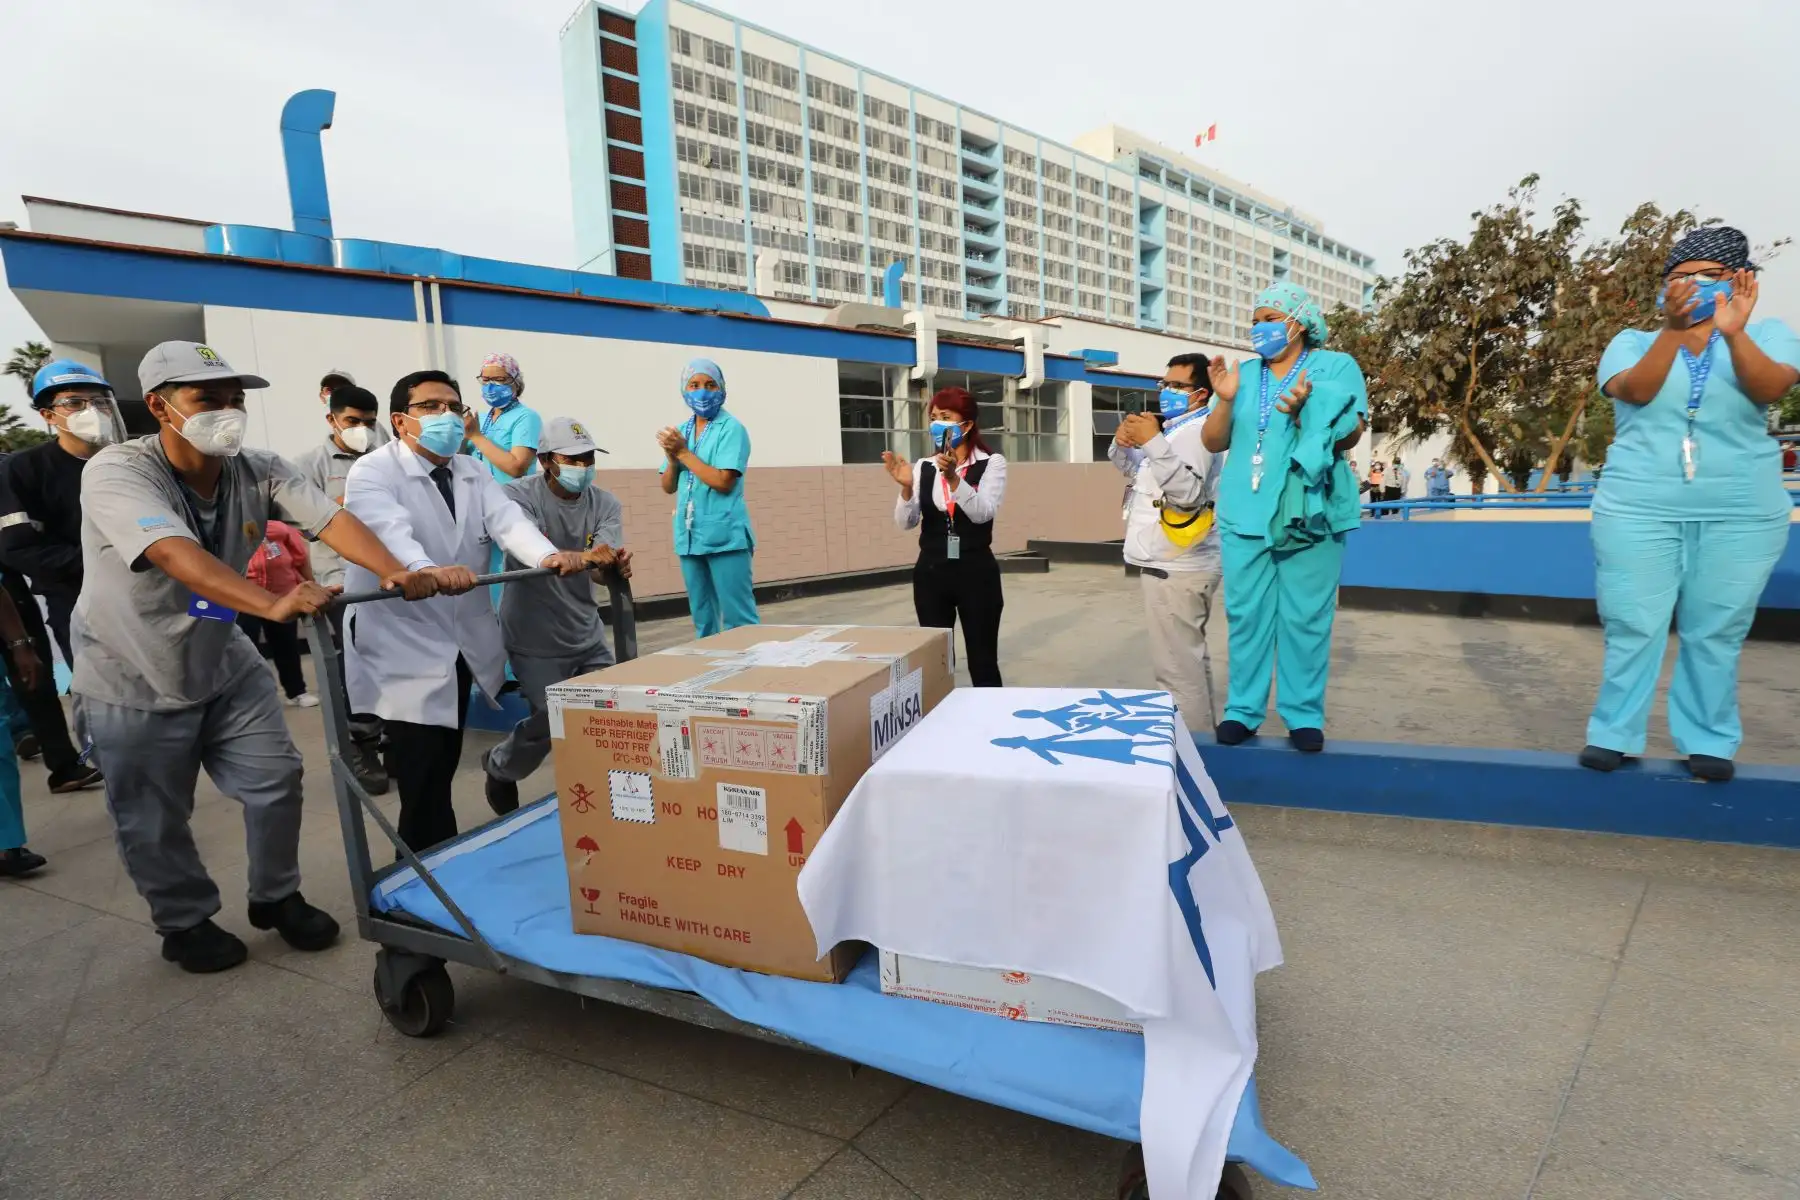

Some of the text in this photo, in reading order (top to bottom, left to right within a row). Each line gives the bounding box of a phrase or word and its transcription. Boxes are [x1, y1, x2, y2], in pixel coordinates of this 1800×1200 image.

[589, 716, 634, 728] Perishable
[874, 692, 921, 751] MINSA
[583, 727, 606, 737] KEEP
[596, 739, 609, 749] DO
[611, 741, 629, 750] NOT
[661, 801, 682, 815] NO
[697, 806, 718, 821] HO
[667, 856, 745, 878] KEEP DRY
[788, 855, 805, 867] UP
[618, 892, 659, 909] Fragile
[620, 909, 751, 943] HANDLE WITH CARE
